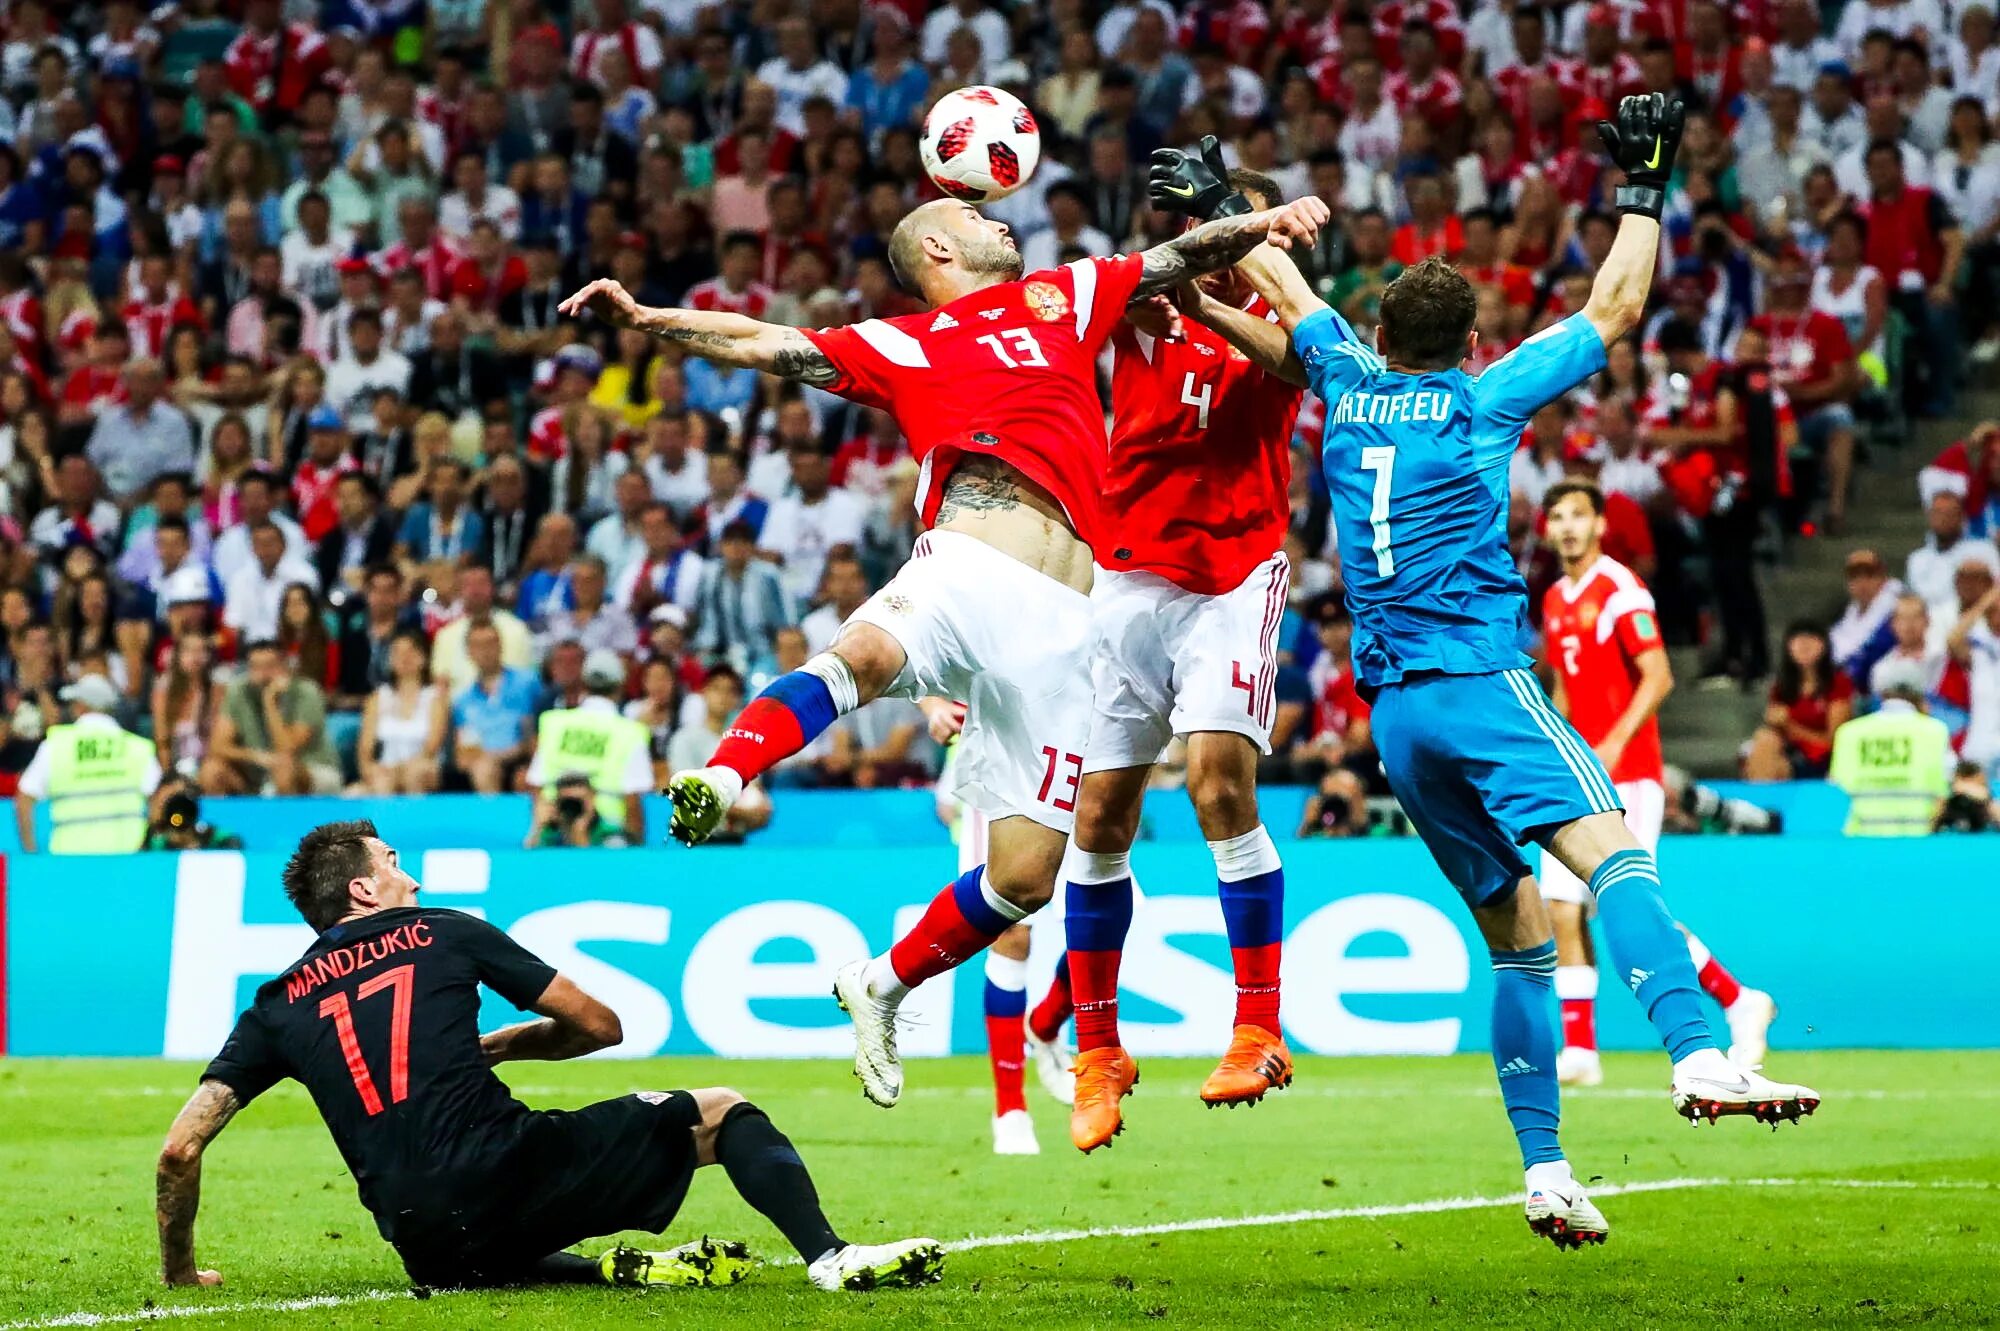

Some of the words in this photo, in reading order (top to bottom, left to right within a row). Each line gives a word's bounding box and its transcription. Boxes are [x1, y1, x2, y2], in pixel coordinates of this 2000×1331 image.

[976, 327, 1050, 368] 13
[1181, 371, 1212, 429] 4
[1360, 445, 1396, 578] 7
[1231, 660, 1255, 717] 4
[1037, 745, 1083, 812] 13
[162, 849, 1469, 1060] Hsense
[318, 963, 415, 1116] 17
